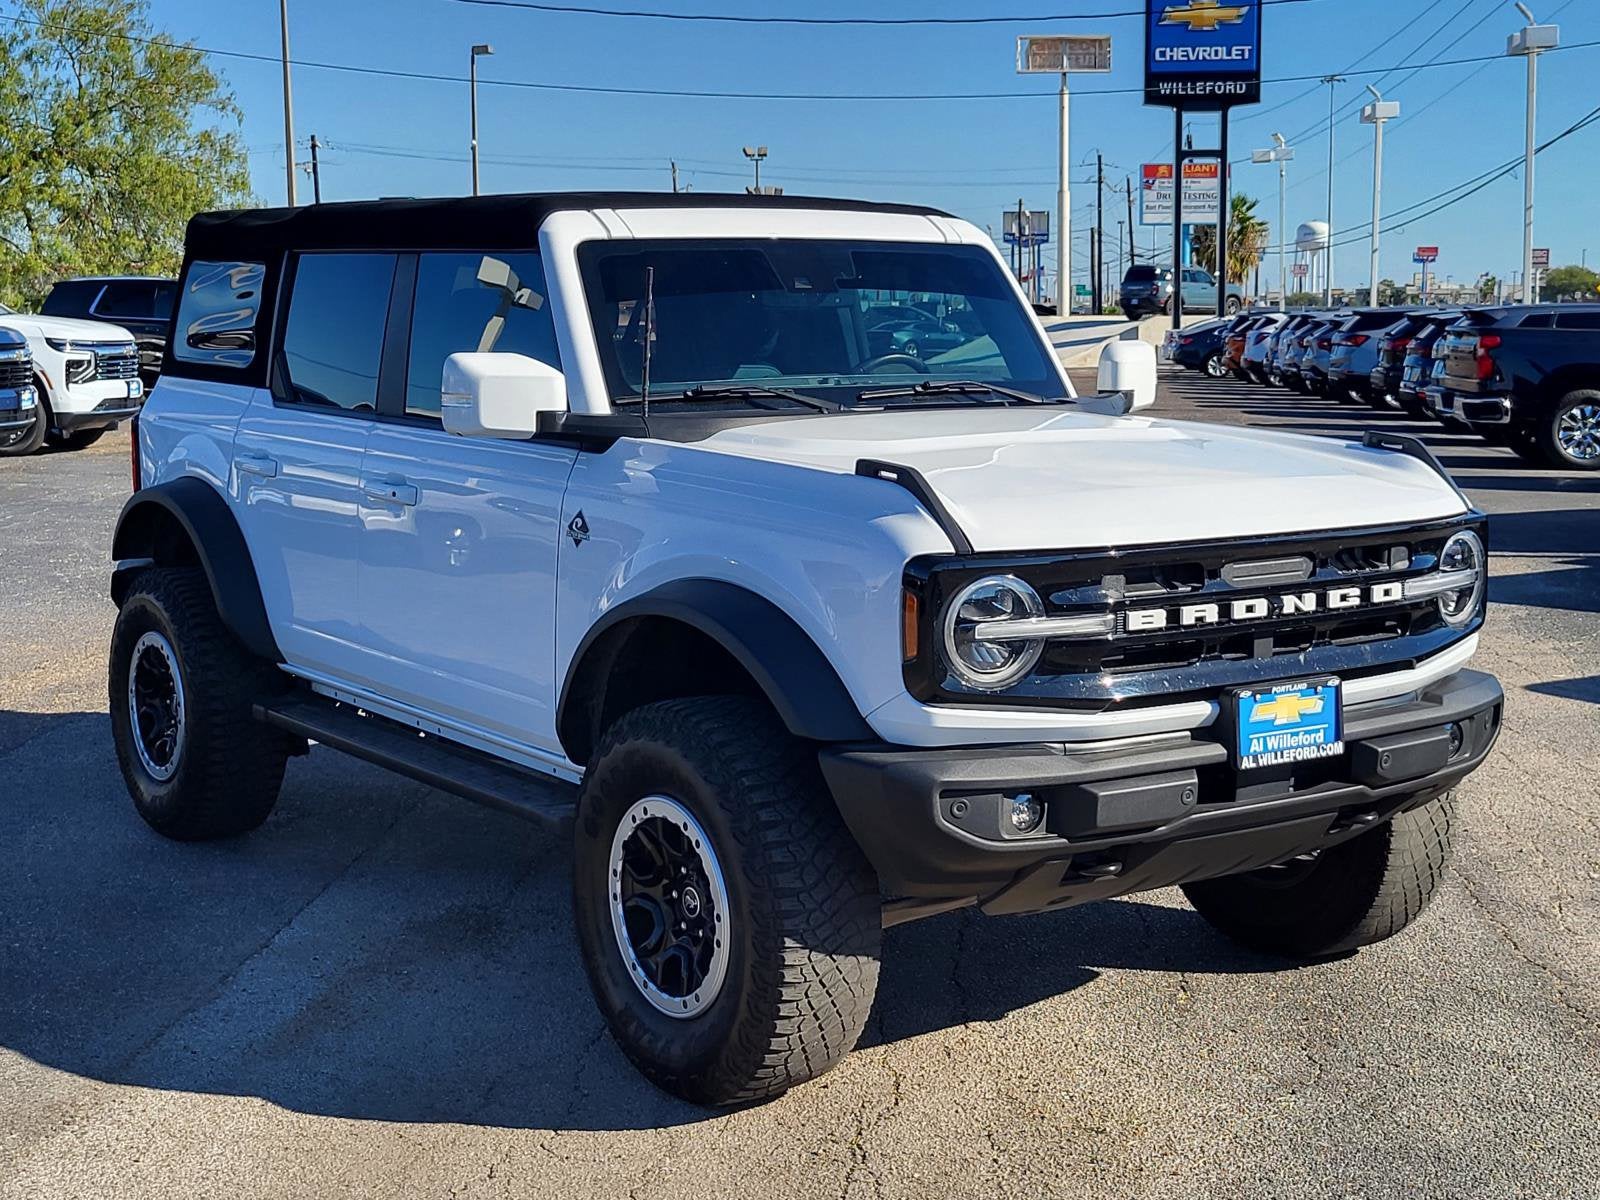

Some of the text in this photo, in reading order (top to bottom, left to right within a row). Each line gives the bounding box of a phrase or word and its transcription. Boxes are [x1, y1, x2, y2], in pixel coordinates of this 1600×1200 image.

[1155, 46, 1252, 60] CHEVROLET
[1160, 82, 1246, 94] WILLEFORD
[1185, 164, 1216, 172] LIANT
[1183, 192, 1217, 200] TESTING
[1126, 582, 1402, 631] BRONCO
[1271, 683, 1308, 694] PORTLAND
[1250, 729, 1324, 753] Al Willeford
[1241, 741, 1344, 769] AL WILLEFORD.COM
